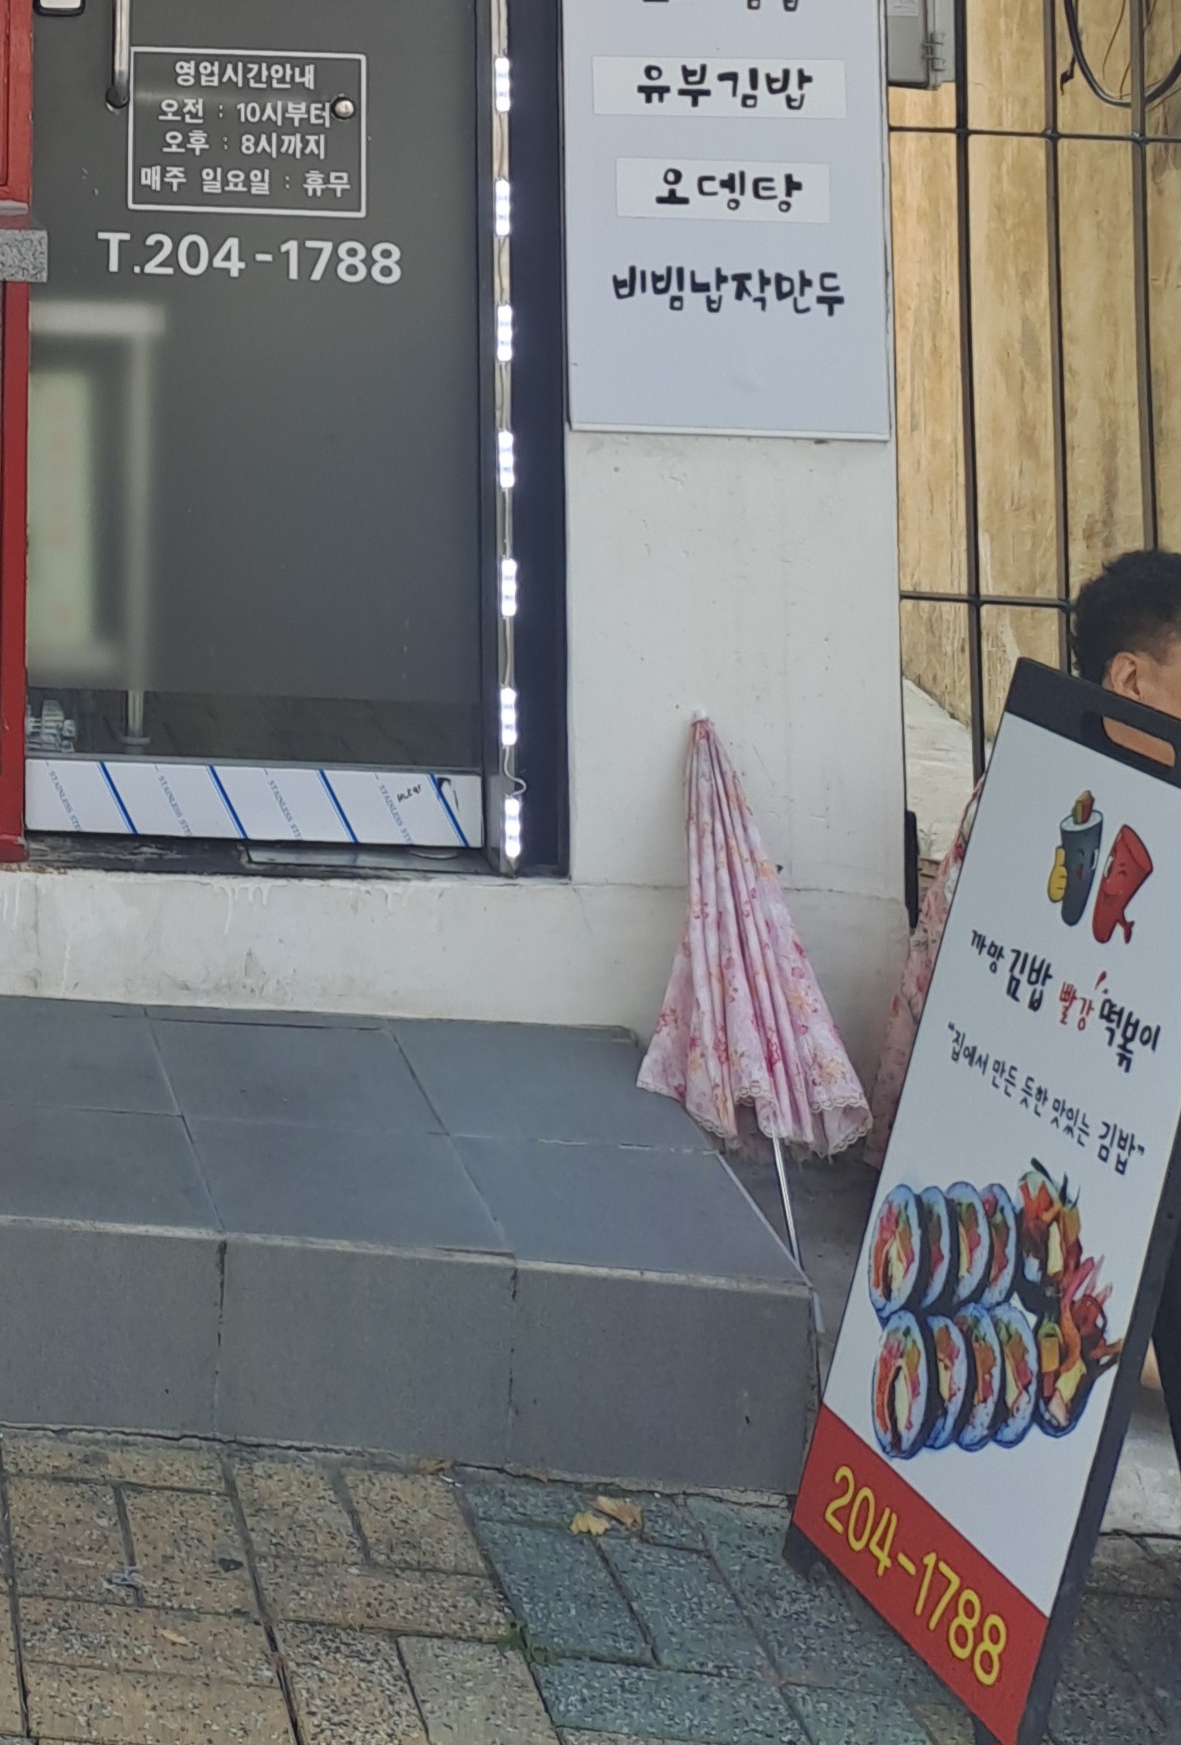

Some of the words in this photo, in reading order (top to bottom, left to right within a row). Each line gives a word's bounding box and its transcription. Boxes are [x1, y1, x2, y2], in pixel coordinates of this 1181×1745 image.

[174, 61, 315, 91] 영업시간안내
[636, 63, 814, 111] 유부김밥
[158, 99, 204, 124] 오전
[236, 101, 332, 128] 10시부터
[162, 130, 209, 156] 오후
[241, 133, 326, 160] 8시까지
[140, 165, 187, 192] 매주
[201, 168, 271, 196] 일요일
[302, 171, 351, 197] 휴무
[655, 168, 803, 214] 오뎅탕
[97, 231, 402, 285] T.204-1788
[612, 265, 846, 317] 비빔납작만두
[971, 929, 1004, 974] 까망
[1006, 948, 1053, 1012] 김밥
[1059, 982, 1095, 1031] 빨강
[1099, 998, 1161, 1073] 떡볶이
[992, 1059, 1018, 1098] 만든
[1020, 1076, 1049, 1118] 듯한
[1051, 1098, 1090, 1148] 맛있는
[824, 1463, 1006, 1687] 204-1788
